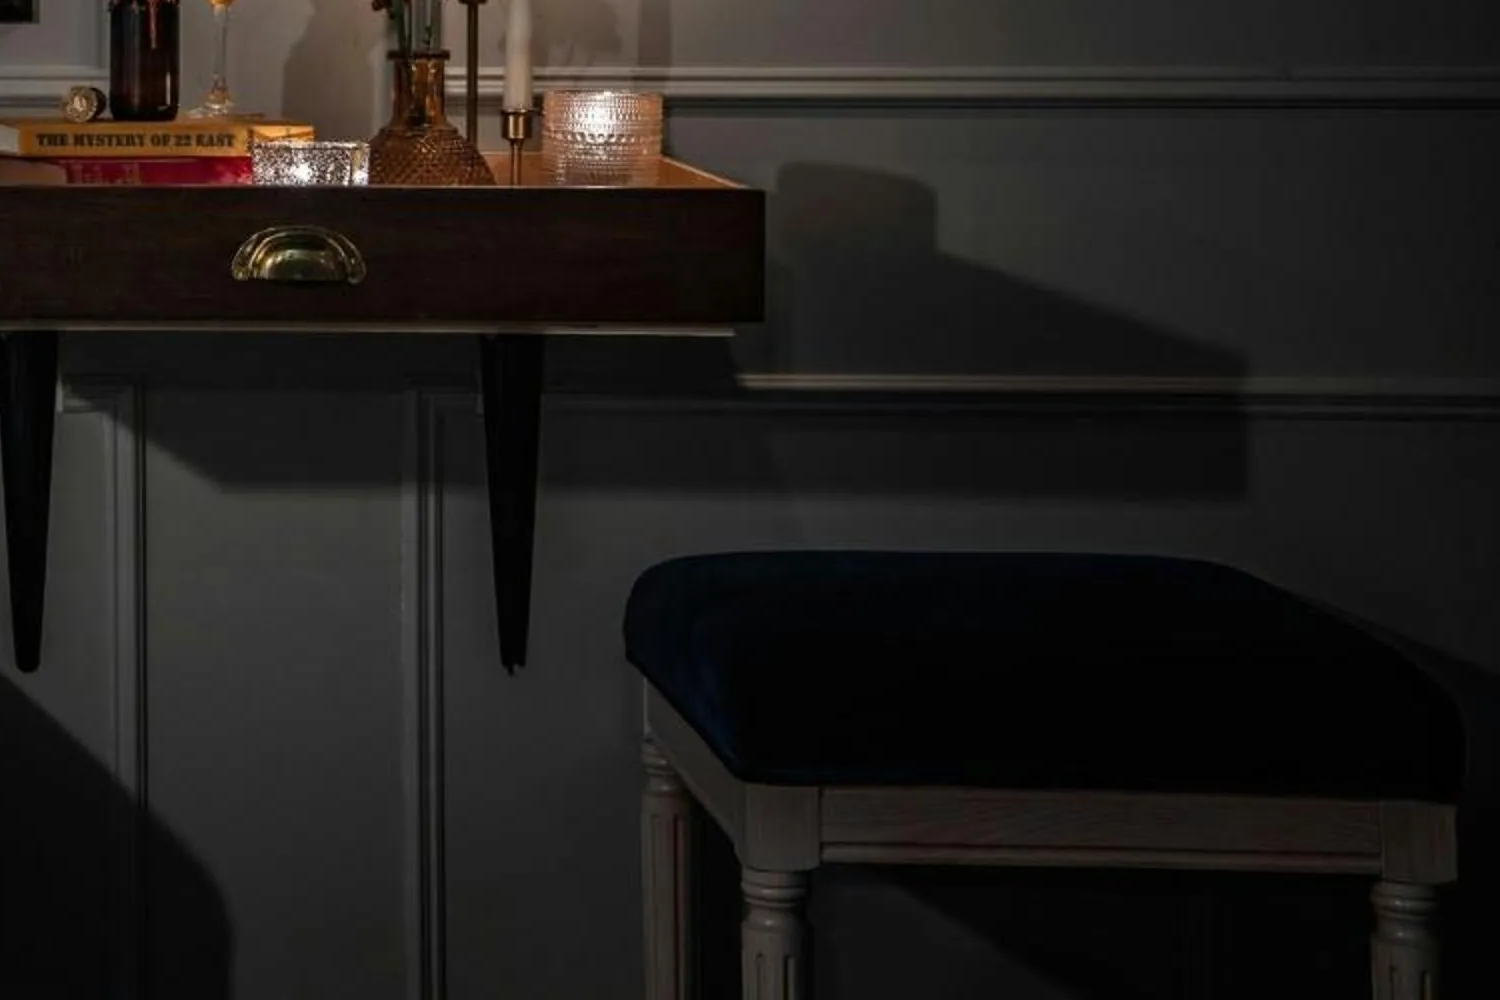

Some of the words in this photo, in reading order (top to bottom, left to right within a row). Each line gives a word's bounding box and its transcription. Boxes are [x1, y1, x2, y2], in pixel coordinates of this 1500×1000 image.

[37, 133, 67, 147] THE
[74, 133, 145, 148] MYSTERY
[151, 133, 169, 147] OF
[174, 134, 191, 147] 22
[196, 133, 234, 148] EAST
